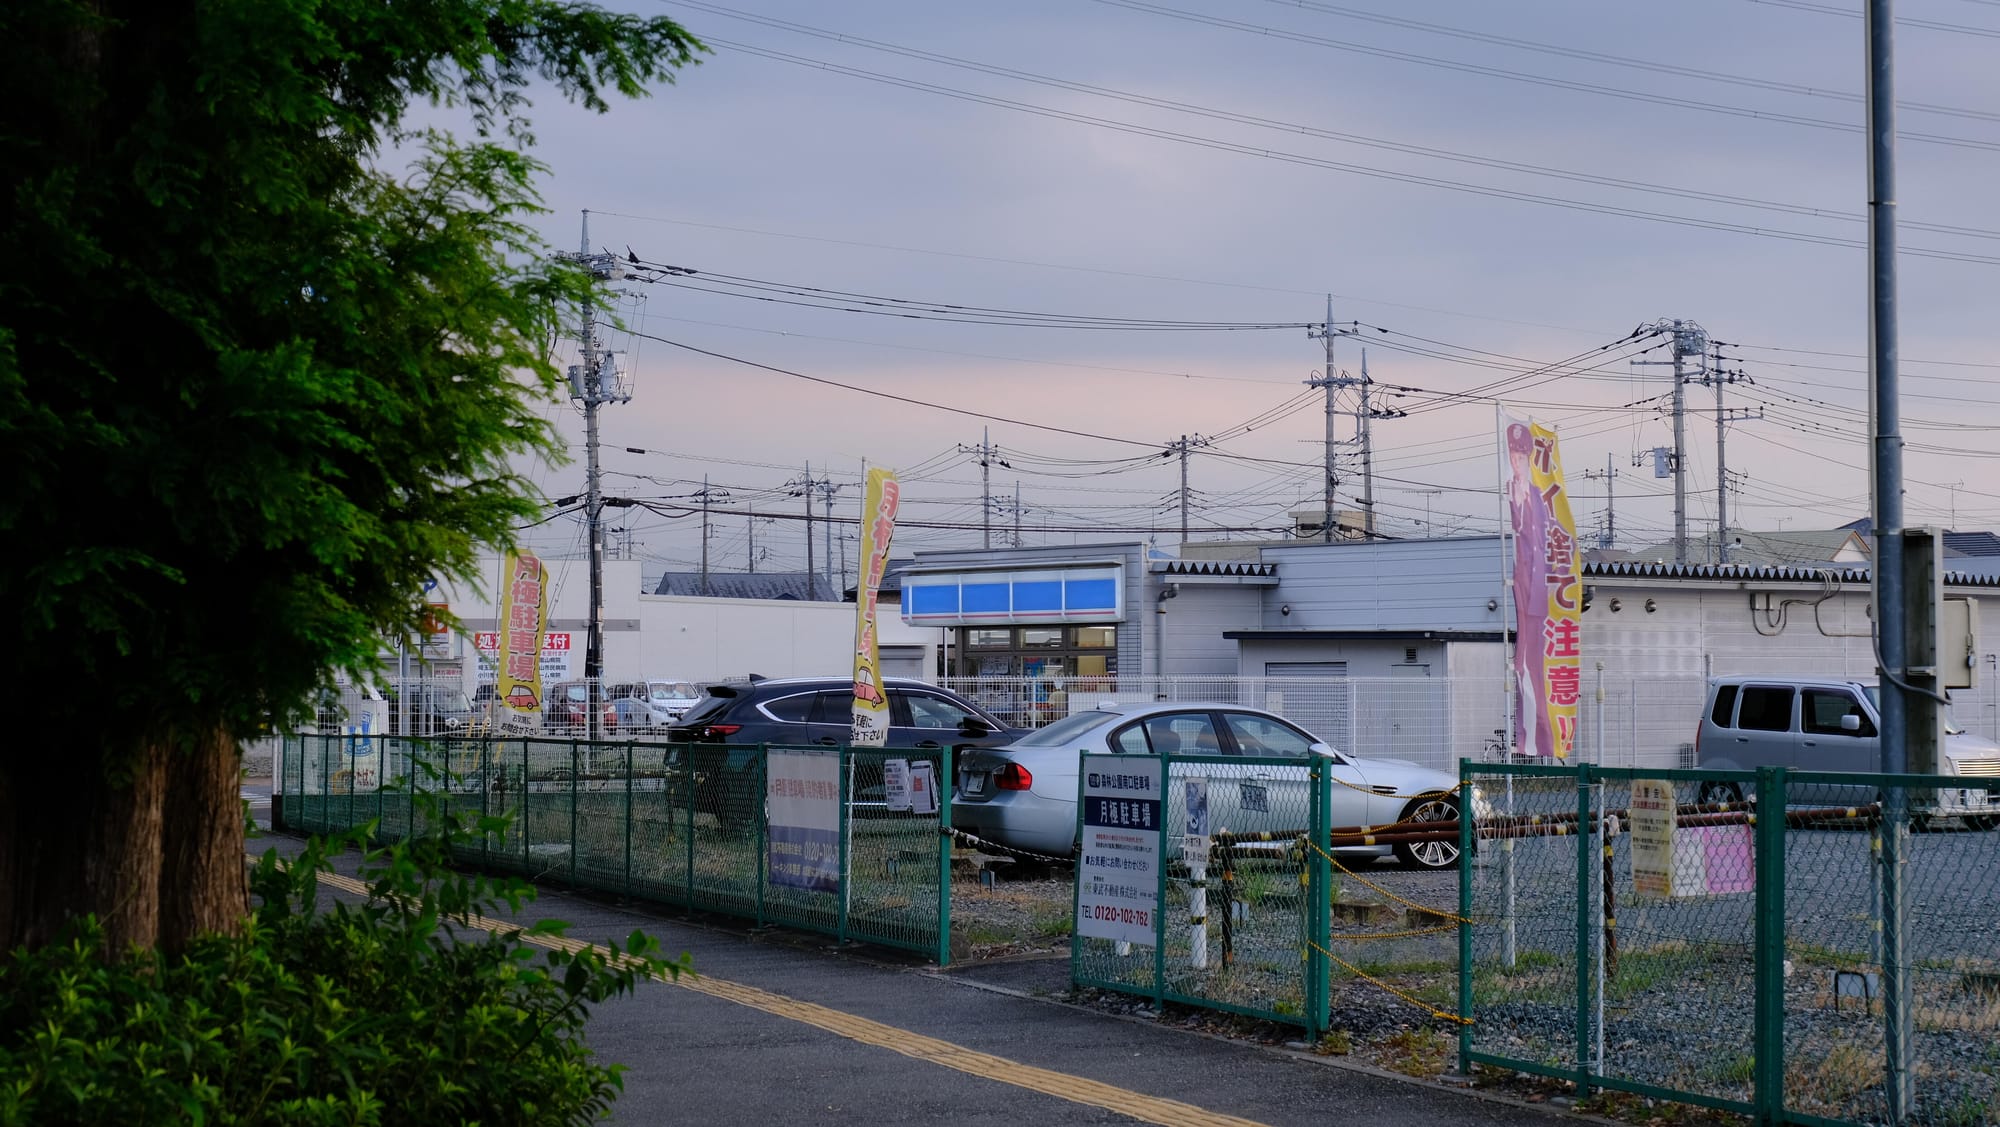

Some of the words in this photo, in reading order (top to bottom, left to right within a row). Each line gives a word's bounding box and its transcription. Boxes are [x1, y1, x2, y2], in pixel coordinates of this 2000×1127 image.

[508, 555, 541, 683] 月極駐車場
[1100, 800, 1151, 828] 月極駐車場
[1082, 905, 1092, 919] TEL
